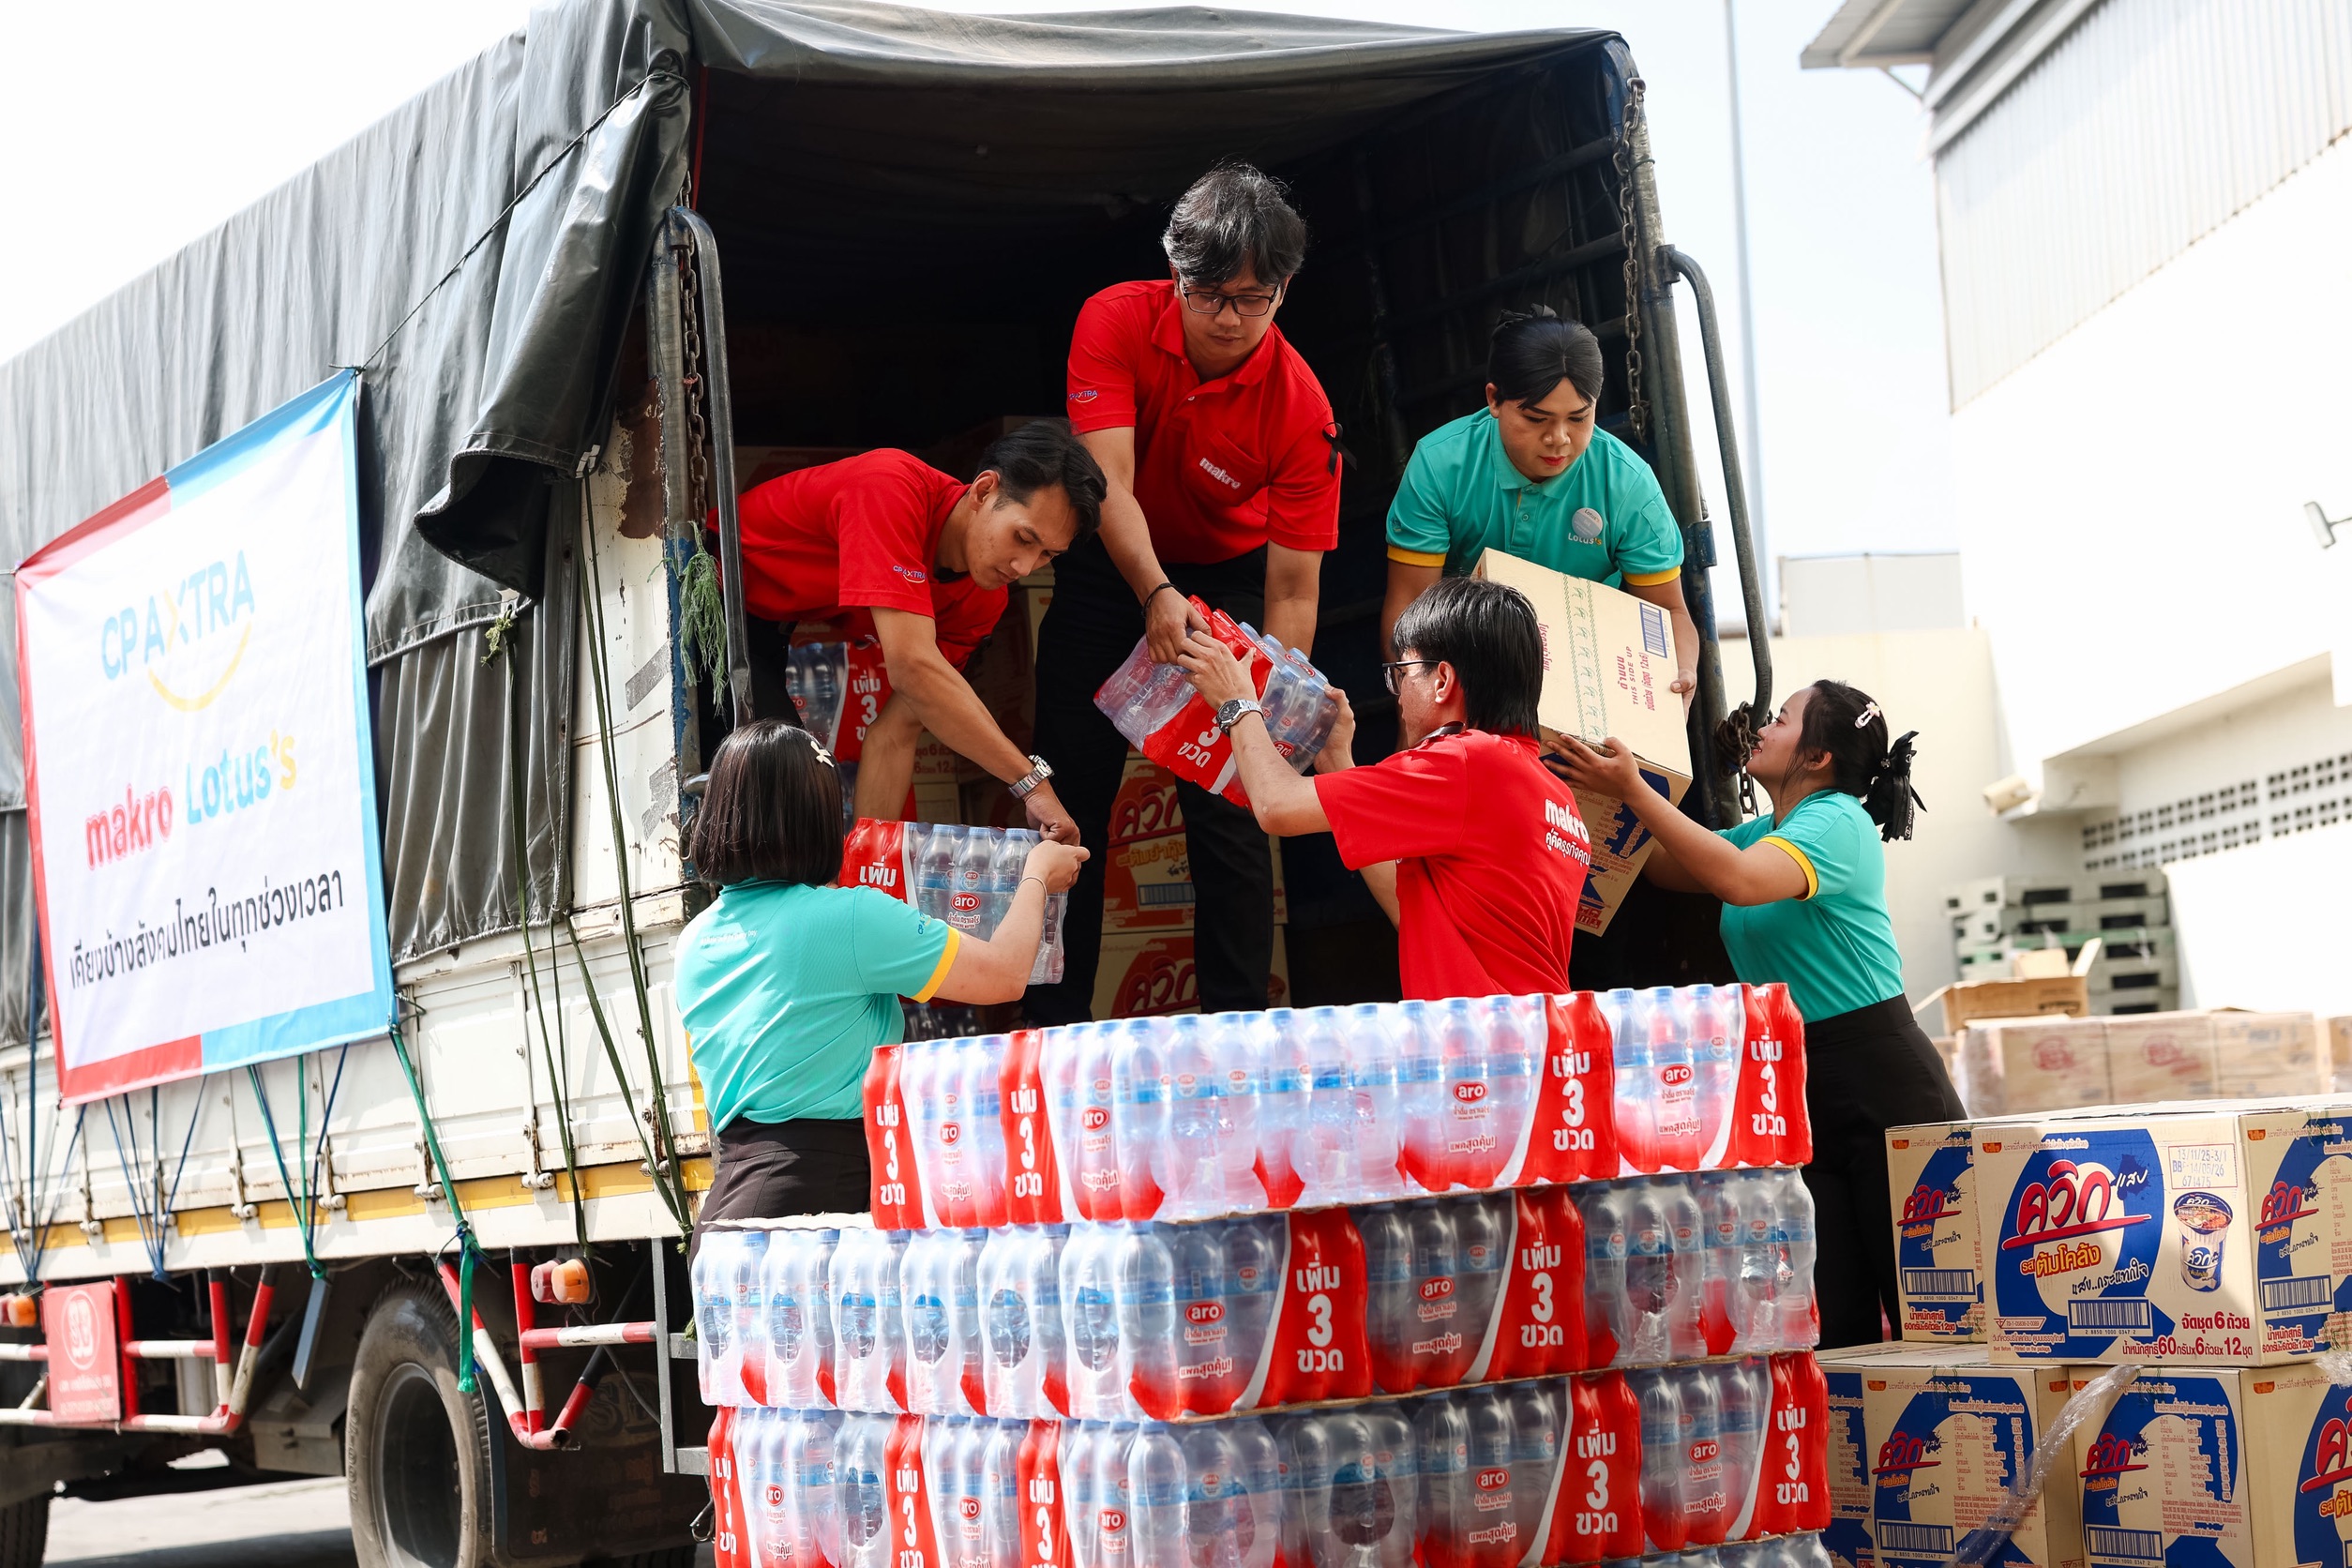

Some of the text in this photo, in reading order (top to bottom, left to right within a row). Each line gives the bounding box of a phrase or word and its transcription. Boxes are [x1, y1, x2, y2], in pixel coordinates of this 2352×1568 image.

[1199, 457, 1241, 490] makro
[101, 550, 255, 681] CP AXTRA
[1625, 645, 1632, 658] UP
[852, 669, 882, 694] เพิ่ม
[1616, 656, 1629, 690] ด้านบน
[860, 695, 878, 726] 3
[1177, 742, 1212, 768] ขวด
[1276, 744, 1294, 757] aro
[85, 729, 297, 870] makro Lotus's
[1545, 798, 1591, 844] makro
[859, 855, 897, 887] เพิ่ม
[954, 897, 976, 907] aro
[69, 868, 344, 989] เคียงข้างสังคมไทยในทุกช่วงเวลา
[1552, 1039, 1591, 1078] เพิ่ม
[1750, 1027, 1783, 1062] เพิ่ม
[1458, 1085, 1484, 1098] aro
[1666, 1068, 1690, 1082] aro
[1760, 1063, 1777, 1113] 3
[1011, 1083, 1038, 1114] เพิ่ม
[1561, 1078, 1585, 1127] 3
[1084, 1112, 1105, 1126] aro
[1751, 1113, 1787, 1137] ขวด
[884, 1129, 899, 1181] 3
[1018, 1116, 1035, 1169] 3
[1553, 1128, 1594, 1152] ขวด
[880, 1183, 906, 1206] ขวด
[1015, 1171, 1042, 1199] ขวด
[2017, 1159, 2111, 1236] ควิก
[1903, 1184, 1944, 1220] ควิก
[2261, 1181, 2302, 1223] ควิก
[1521, 1232, 1560, 1270] เพิ่ม
[2036, 1243, 2101, 1277] ต้มโคล้ง
[1296, 1252, 1340, 1292] เพิ่ม
[1425, 1281, 1450, 1296] aro
[1191, 1305, 1219, 1320] aro
[1530, 1272, 1554, 1323] 3
[1306, 1293, 1333, 1348] 3
[1520, 1324, 1563, 1348] ขวด
[2181, 1312, 2212, 1334] จัดชุด
[1181, 1357, 1232, 1379] แพคสุดคุ้ม!
[1297, 1349, 1344, 1373] ขวด
[1777, 1395, 1806, 1431] เพิ่ม
[1577, 1419, 1616, 1458] เพิ่ม
[1694, 1444, 1717, 1458] aro
[1878, 1431, 1923, 1469] ควิก
[2087, 1433, 2131, 1470] ควิก
[1786, 1433, 1800, 1481] 3
[896, 1460, 918, 1493] เพิ่ม
[1029, 1468, 1055, 1505] เพิ่ม
[1481, 1471, 1505, 1486] aro
[1586, 1459, 1609, 1510] 3
[1776, 1482, 1809, 1504] ขวด
[1684, 1492, 1726, 1513] แพคสุดคุ้ม!
[902, 1495, 917, 1547] 3
[1035, 1506, 1053, 1560] 3
[1101, 1513, 1121, 1527] aro
[1470, 1522, 1515, 1543] แพคสุดคุ้ม!
[1576, 1512, 1618, 1535] ขวด
